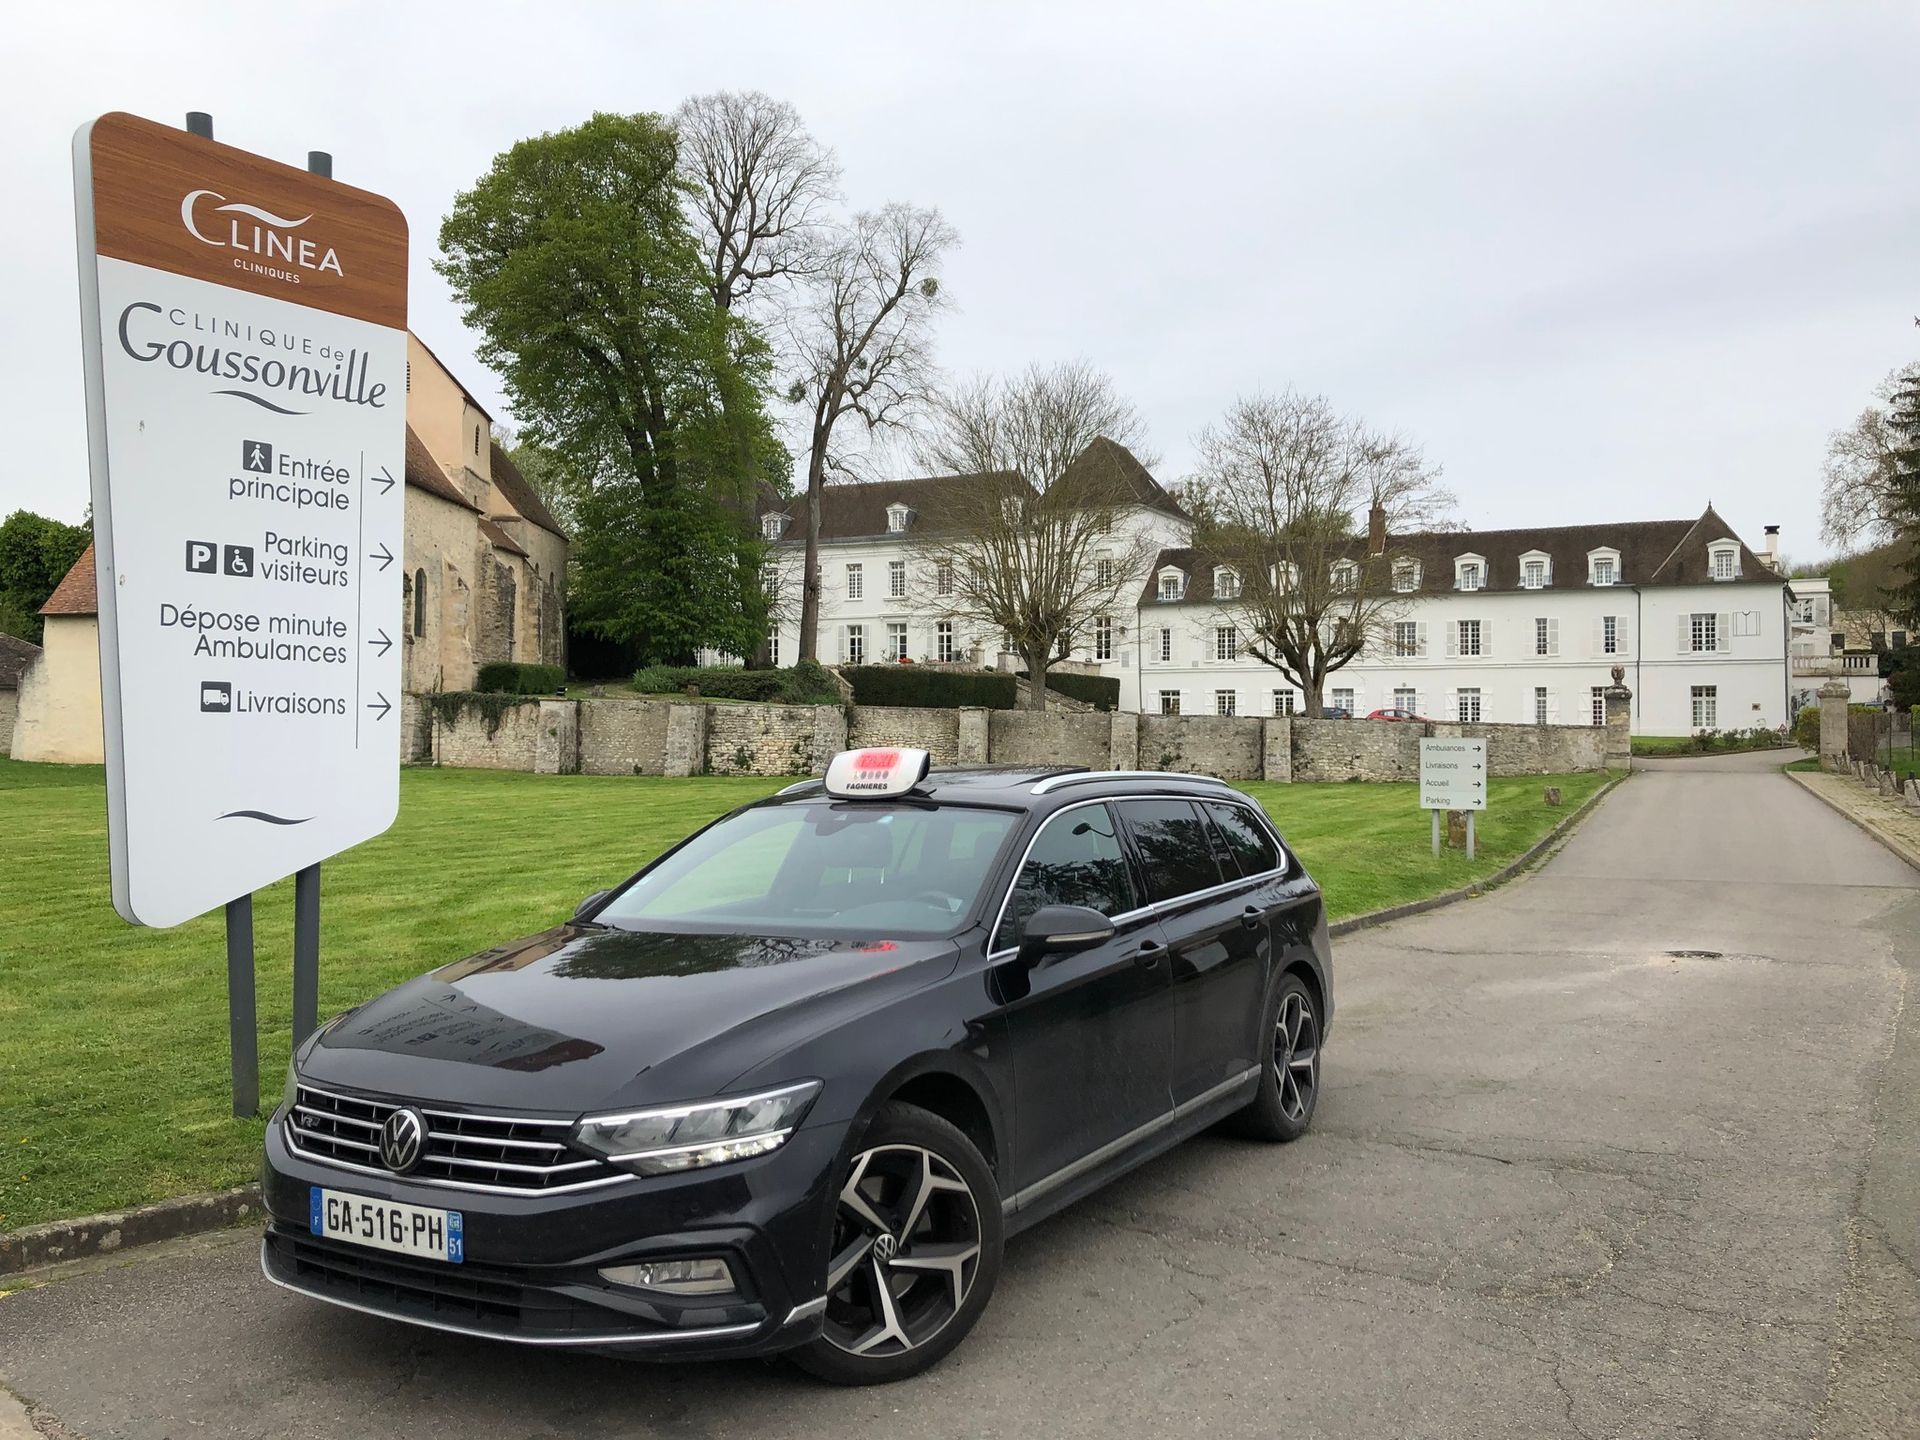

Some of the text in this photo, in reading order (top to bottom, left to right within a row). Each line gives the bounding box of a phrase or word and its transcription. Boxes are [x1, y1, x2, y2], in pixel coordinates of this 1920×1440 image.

[181, 189, 344, 277] CLINEA
[233, 258, 301, 284] CLINIQUES
[169, 308, 344, 361] CLINIQUE de
[118, 301, 387, 408] Goussonville
[278, 453, 350, 485] Entrée
[229, 477, 350, 510] principale
[265, 531, 348, 566] Parking
[260, 560, 348, 587] visiteurs
[160, 603, 347, 638] Dépose minute
[193, 633, 347, 664] Ambulances
[236, 690, 346, 715] Livraisons
[1425, 744, 1465, 752] Ambulances
[1425, 779, 1450, 787] Accueil
[1425, 797, 1450, 805] Parking
[327, 1197, 443, 1251] GA-516-PH
[449, 1237, 462, 1256] 51
